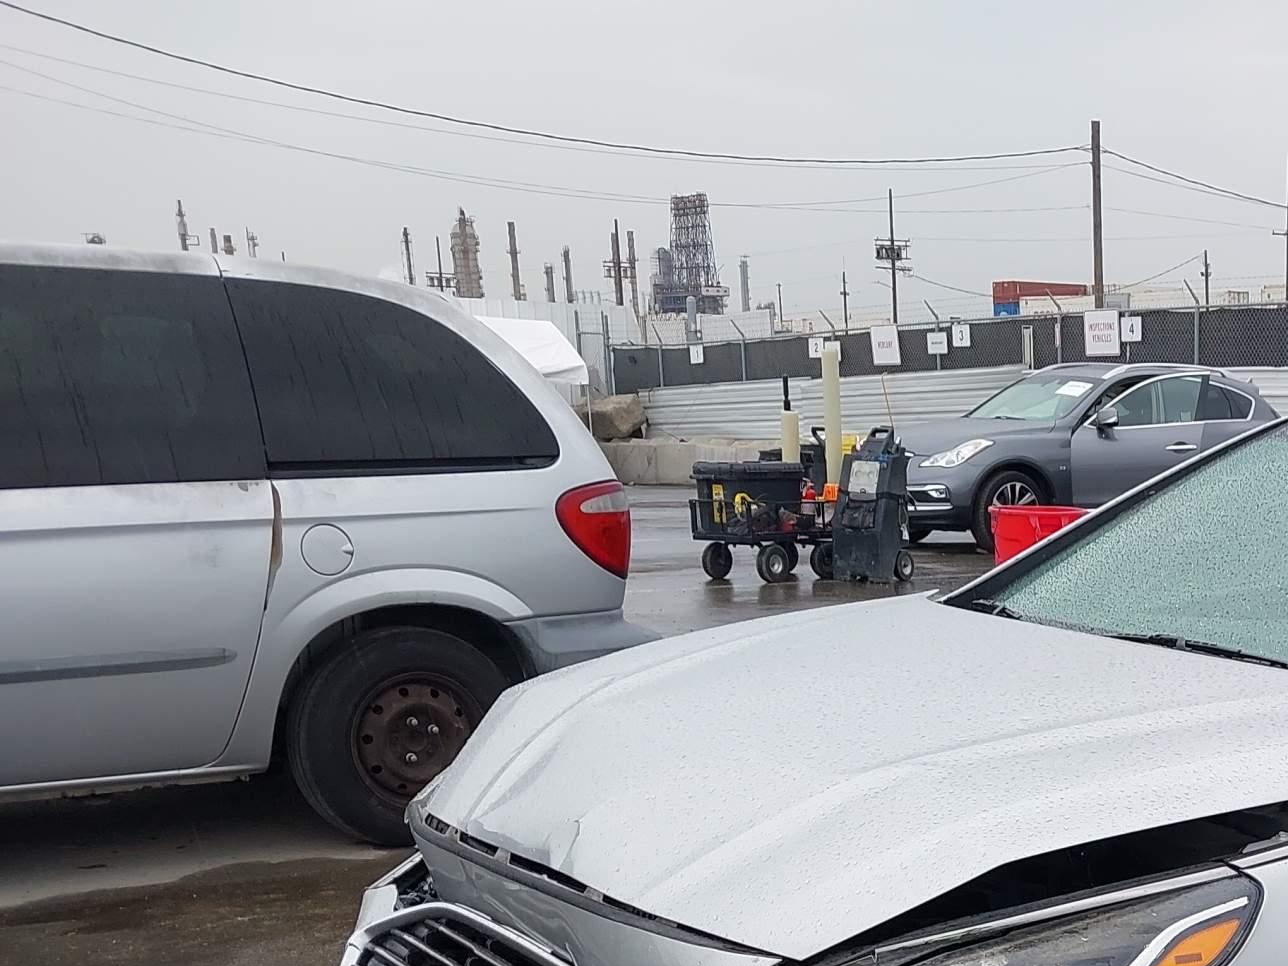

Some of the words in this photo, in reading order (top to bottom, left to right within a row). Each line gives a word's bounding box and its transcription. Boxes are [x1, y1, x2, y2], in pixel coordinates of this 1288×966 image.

[1128, 323, 1135, 335] 4
[959, 330, 964, 341] 3
[814, 342, 819, 352] 2
